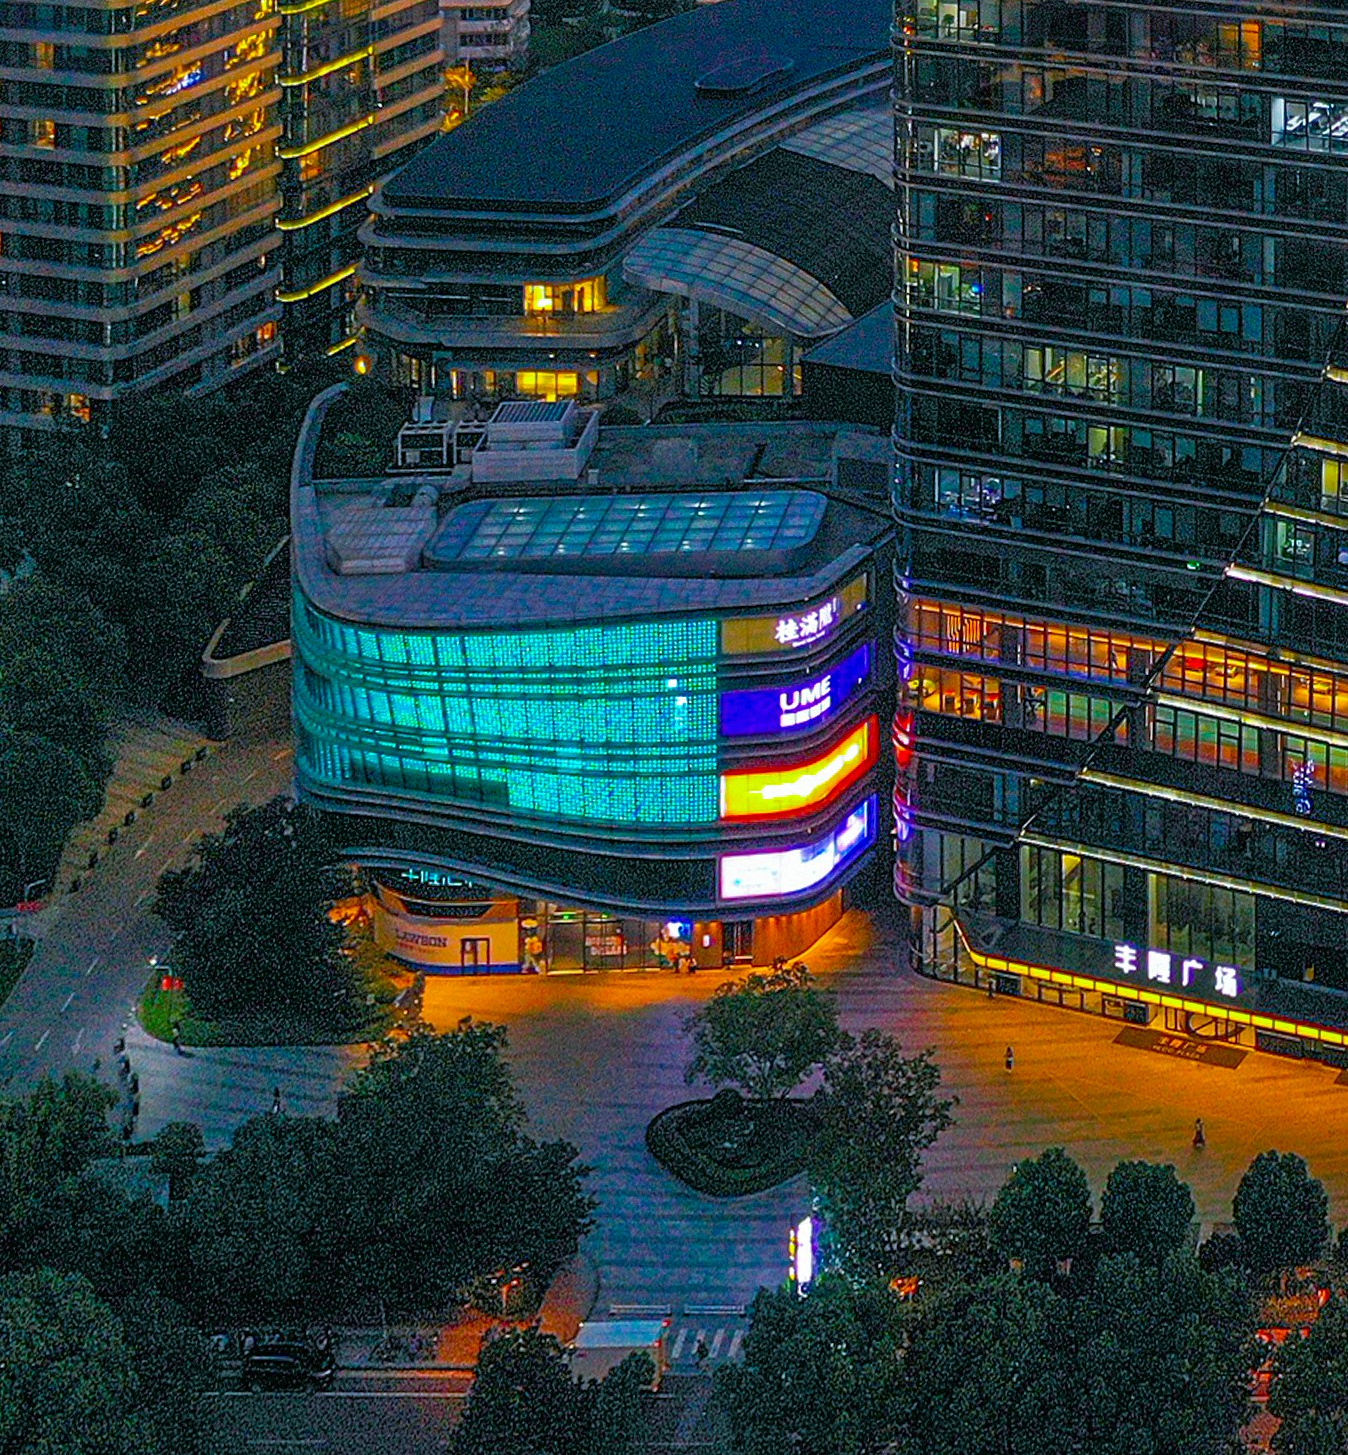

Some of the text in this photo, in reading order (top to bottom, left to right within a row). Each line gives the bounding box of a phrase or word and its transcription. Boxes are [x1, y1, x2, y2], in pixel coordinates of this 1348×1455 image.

[780, 674, 831, 710] UME
[1114, 944, 1238, 998] 丰隆广场
